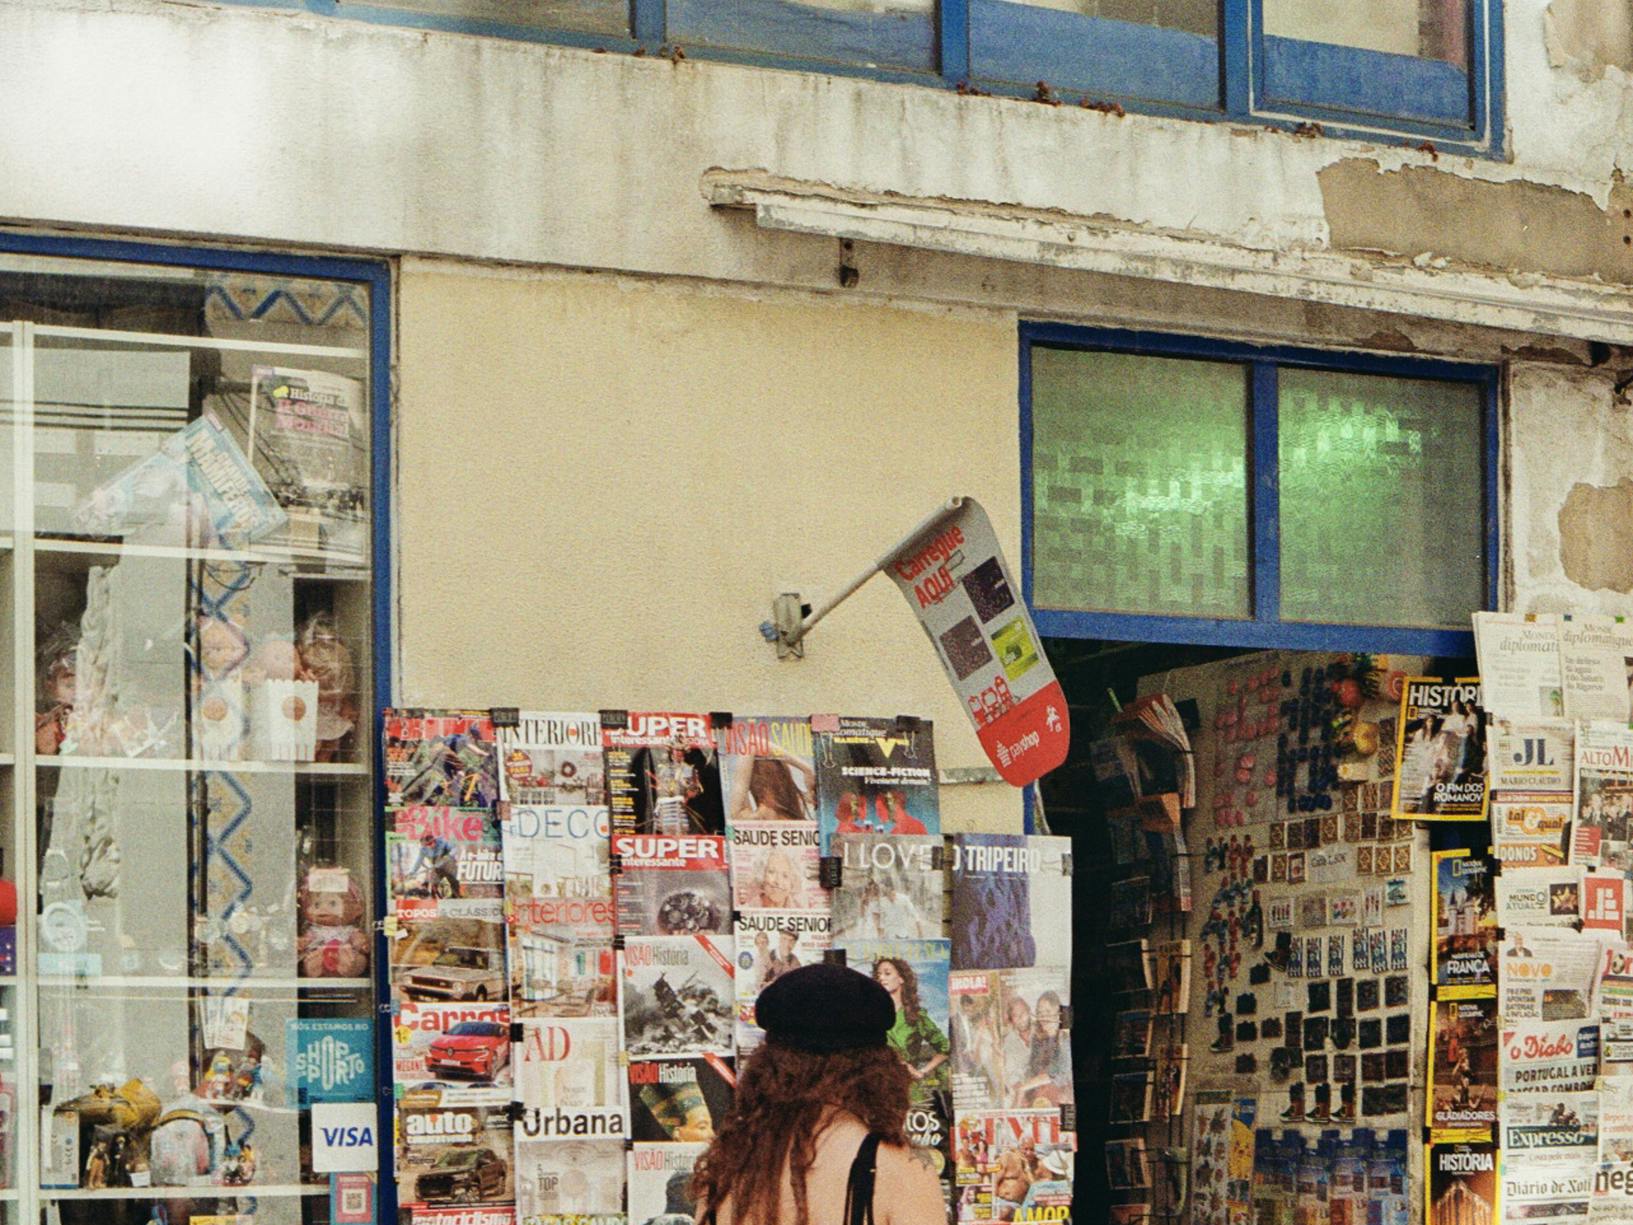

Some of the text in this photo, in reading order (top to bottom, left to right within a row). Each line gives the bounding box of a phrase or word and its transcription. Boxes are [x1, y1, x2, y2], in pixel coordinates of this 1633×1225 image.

[895, 526, 965, 582] Carregue
[914, 564, 957, 609] AQUI
[1009, 730, 1040, 762] payshop
[1514, 739, 1554, 766] JL
[406, 806, 483, 841] Bike
[616, 837, 719, 859] SUPER
[860, 842, 933, 870] LOVE
[966, 845, 1040, 873] TRIPEIRO
[1447, 959, 1490, 976] FRANÇA
[1506, 963, 1552, 977] NOVO
[524, 1026, 571, 1062] AD
[1524, 1033, 1574, 1058] Diabo
[1515, 1066, 1578, 1083] PORTUGAL A
[406, 1111, 473, 1135] auto
[523, 1107, 624, 1137] Urbana
[1436, 1110, 1494, 1122] GLADIADORES
[321, 1127, 374, 1147] VISA
[1508, 1127, 1584, 1148] Expresso
[1506, 1180, 1566, 1197] Diário de
